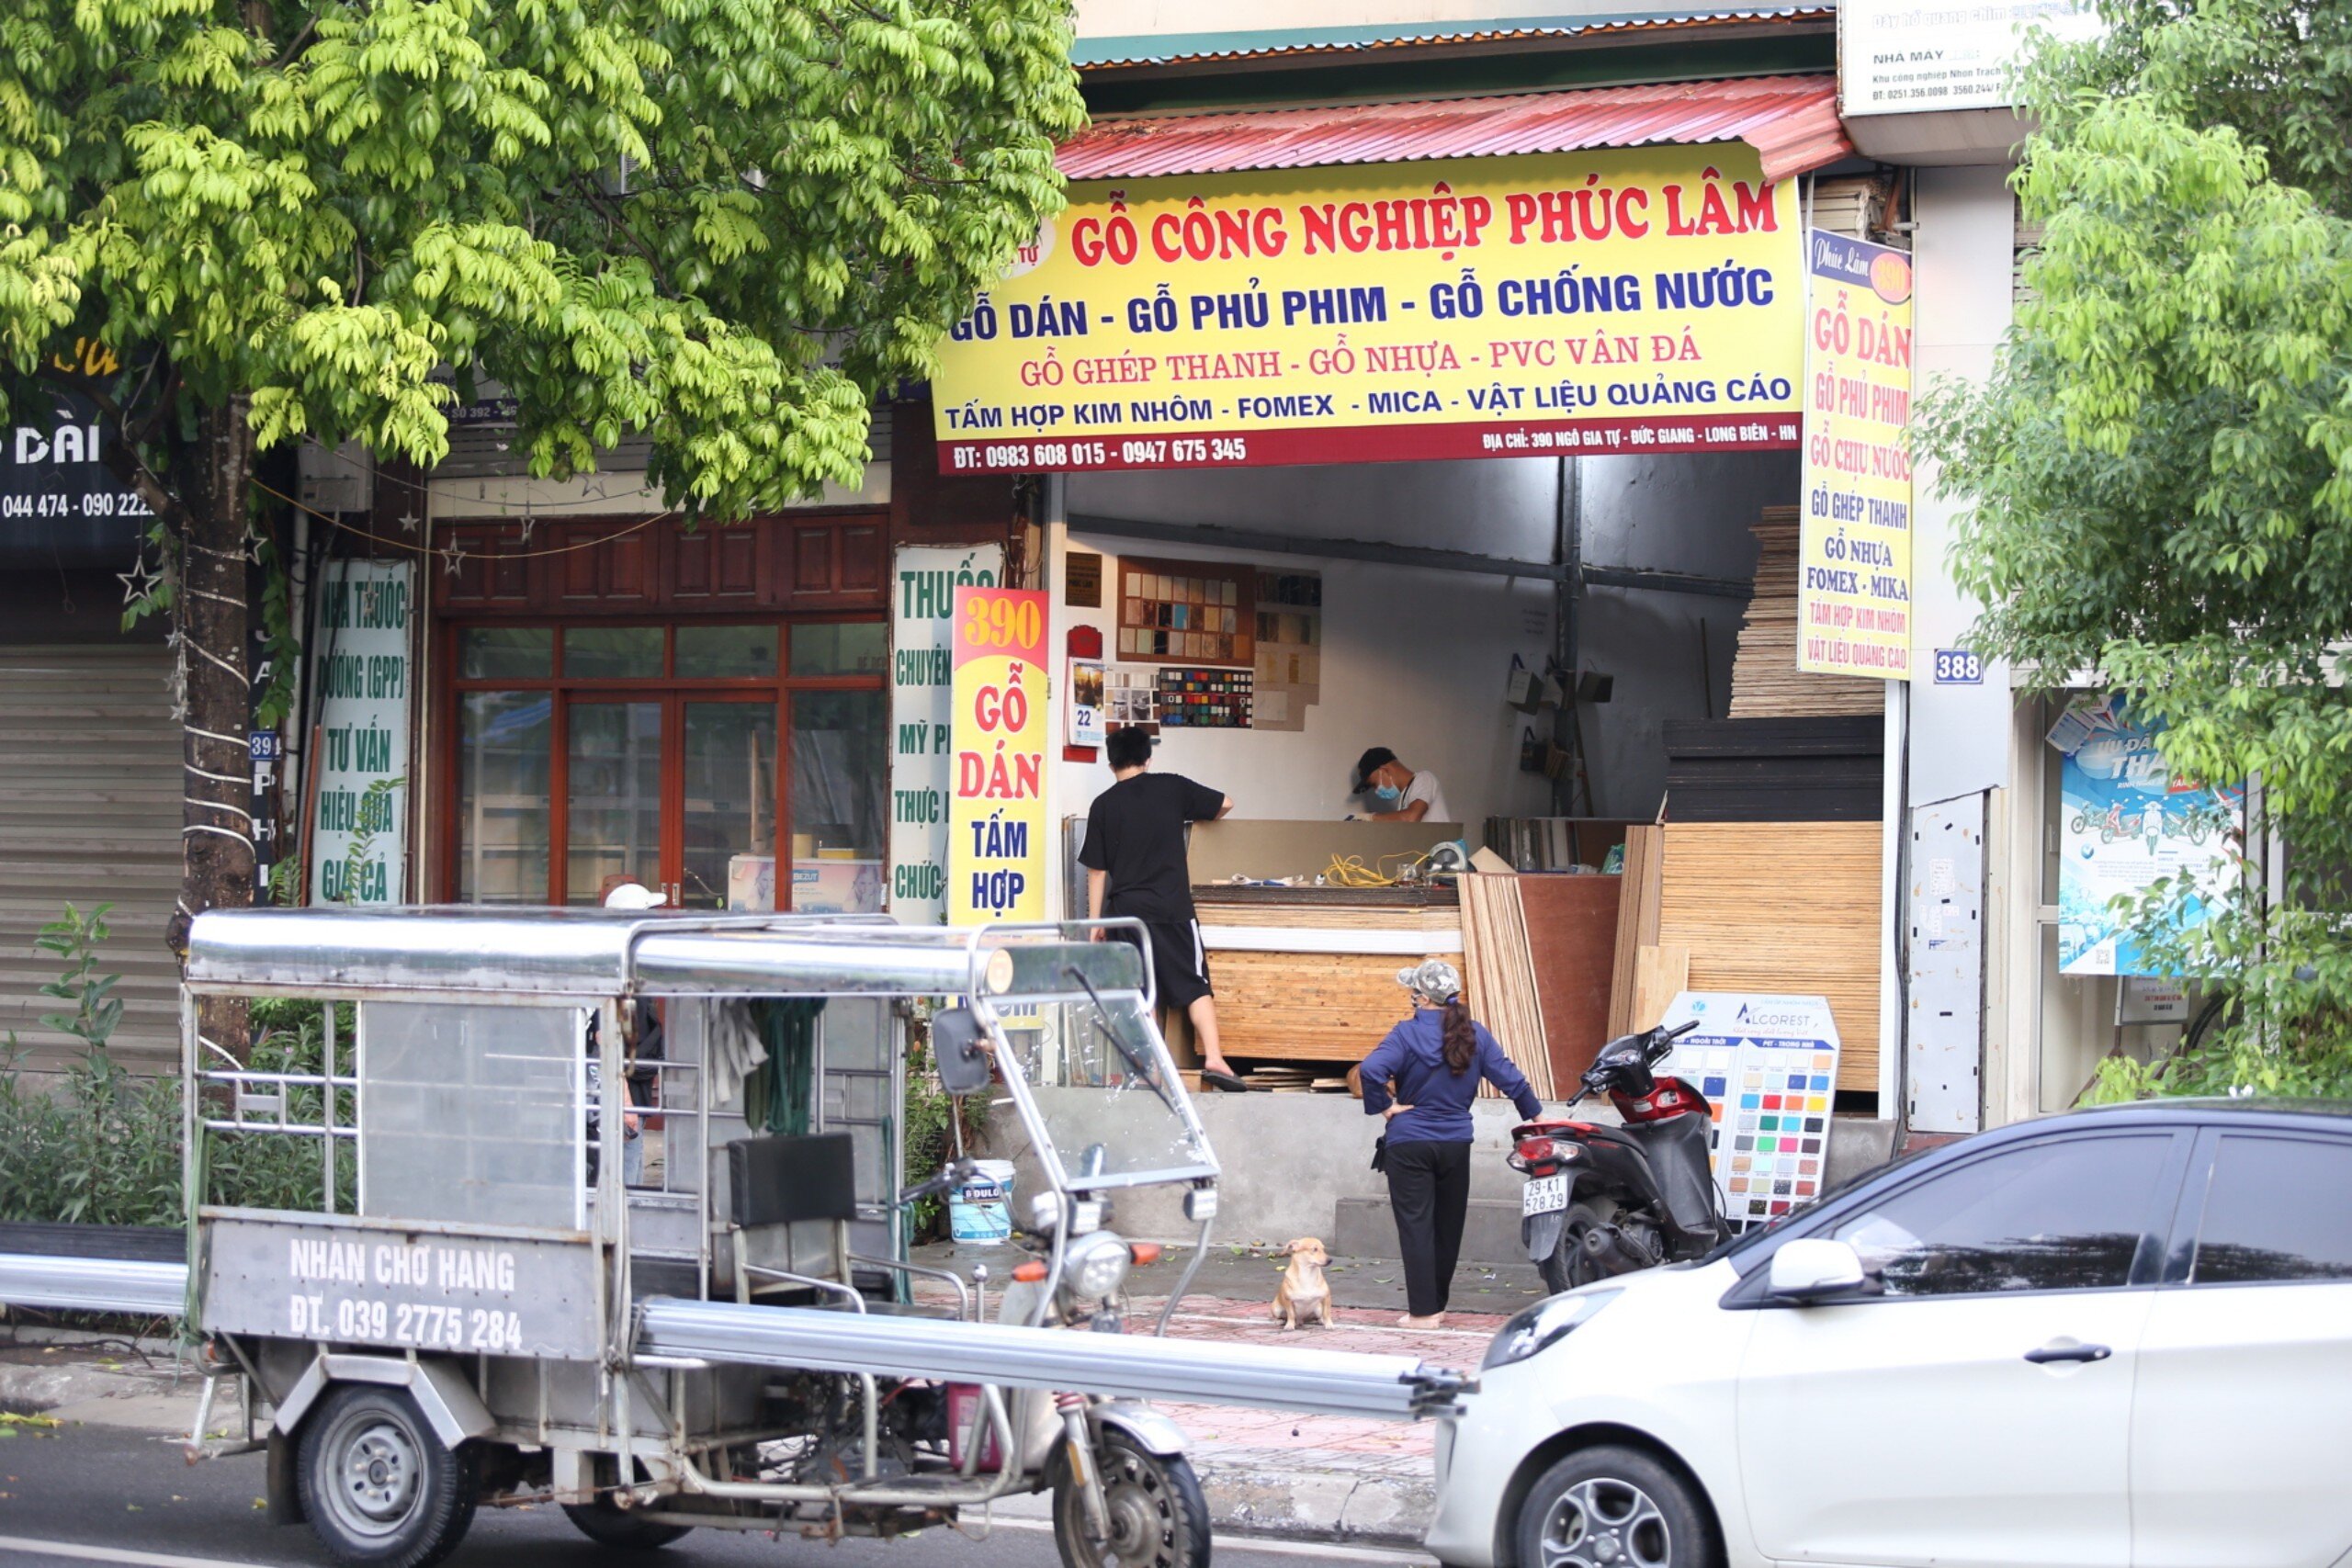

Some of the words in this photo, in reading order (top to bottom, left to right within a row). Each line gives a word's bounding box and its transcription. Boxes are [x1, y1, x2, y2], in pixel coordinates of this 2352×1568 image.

[1071, 190, 1138, 267] GỖ
[1151, 196, 1288, 263] CÔNG
[1299, 180, 1492, 263] NGHIỆP
[1505, 175, 1650, 245] PHÚC
[1661, 166, 1779, 236] LÂM
[950, 292, 998, 342] GỖ
[1010, 295, 1088, 339] DÁN
[1127, 283, 1178, 333] GỖ
[1191, 277, 1269, 331] PHỦ
[1283, 286, 1387, 326] PHIM
[1430, 268, 1483, 319] GỖ
[1498, 264, 1642, 316] CHỐNG
[1655, 259, 1774, 310] NƯỚC
[1877, 260, 1905, 293] 390
[1815, 289, 1849, 355] GỖ
[1857, 310, 1911, 369] DÁN
[1021, 346, 1063, 387] GỖ
[1072, 349, 1158, 386] GHÉP
[1166, 351, 1283, 381] THANH
[1308, 333, 1355, 375] GỖ
[1364, 342, 1461, 383] NHỰA
[1489, 340, 1555, 368] PVC
[1565, 329, 1639, 365] VÂN
[1651, 325, 1702, 362] ĐÁ
[469, 407, 491, 418] 392
[944, 399, 1002, 430] TẤM
[1012, 403, 1065, 433] HỢP
[1074, 400, 1122, 424] KIM
[1131, 395, 1213, 423] NHÔM
[1238, 393, 1335, 419] FOMEX
[1369, 389, 1442, 413] MICA
[1469, 382, 1525, 415] VẬT
[1535, 379, 1597, 413] LIỆU
[1608, 373, 1716, 406] QUẢNG
[1726, 373, 1792, 400] CÁO
[1815, 361, 1835, 412] GỖ
[1839, 369, 1867, 419] PHỦ
[1872, 384, 1908, 426] PHIM
[954, 446, 981, 468] ĐT:
[986, 445, 1029, 468] 0983
[1034, 444, 1067, 466] 608
[1072, 443, 1104, 465] 015
[1123, 441, 1167, 463] 0947
[1172, 439, 1206, 461] 675
[1212, 438, 1246, 460] 345
[1483, 434, 1503, 452] ĐỊA
[1506, 427, 1529, 448] CHỈ:
[1532, 432, 1553, 447] 390
[1555, 428, 1579, 446] NGÔ
[1583, 431, 1602, 446] GIA
[1605, 429, 1621, 448] TỰ
[1631, 425, 1655, 445] ĐỨC
[1657, 428, 1694, 444] GIANG
[1705, 426, 1737, 442] LONG
[1739, 423, 1768, 442] BIÊN
[1780, 425, 1796, 441] HN
[1811, 420, 1830, 468] GỖ
[1835, 439, 1868, 482] CHỊU
[1872, 439, 1911, 482] NƯỚC
[3, 494, 33, 517] 044
[38, 494, 69, 516] 474
[83, 493, 114, 516] 090
[1812, 481, 1828, 518] GỖ
[1832, 490, 1864, 523] GHÉP
[1868, 498, 1907, 530] THANH
[1825, 526, 1846, 559] GỖ
[1849, 540, 1893, 570] NHỰA
[355, 567, 405, 629] THUỐC
[1806, 567, 1859, 594] FOMEX
[1871, 574, 1909, 601] MIKA
[964, 595, 1042, 649] 390
[1810, 595, 1830, 626] TẤM
[1834, 605, 1853, 632] HỢP
[1856, 608, 1875, 630] KIM
[1877, 607, 1905, 634] NHÔM
[896, 643, 952, 686] CHUYÊN
[1807, 635, 1826, 666] VẬT
[1828, 637, 1849, 668] LIỆU
[1852, 637, 1885, 667] QUẢNG
[1887, 643, 1906, 670] CÁO
[1937, 655, 1980, 679] 388
[367, 655, 405, 699] (GPP)
[974, 662, 1028, 733] GỖ
[899, 719, 928, 754] MỸ
[1078, 710, 1091, 727] 22
[328, 722, 353, 773] TƯ
[356, 715, 391, 773] VẤN
[957, 739, 1042, 799] DÁN
[321, 784, 356, 839] HIỆU
[895, 785, 939, 829] THỰC
[971, 808, 1027, 859] TẤM
[360, 852, 387, 901] CẢ
[895, 860, 942, 899] CHỨC
[972, 870, 1024, 918] HỢP
[1525, 1193, 1563, 1212] 528.29
[339, 1299, 388, 1338] 039
[396, 1303, 462, 1346] 2775
[470, 1309, 522, 1349] 284
